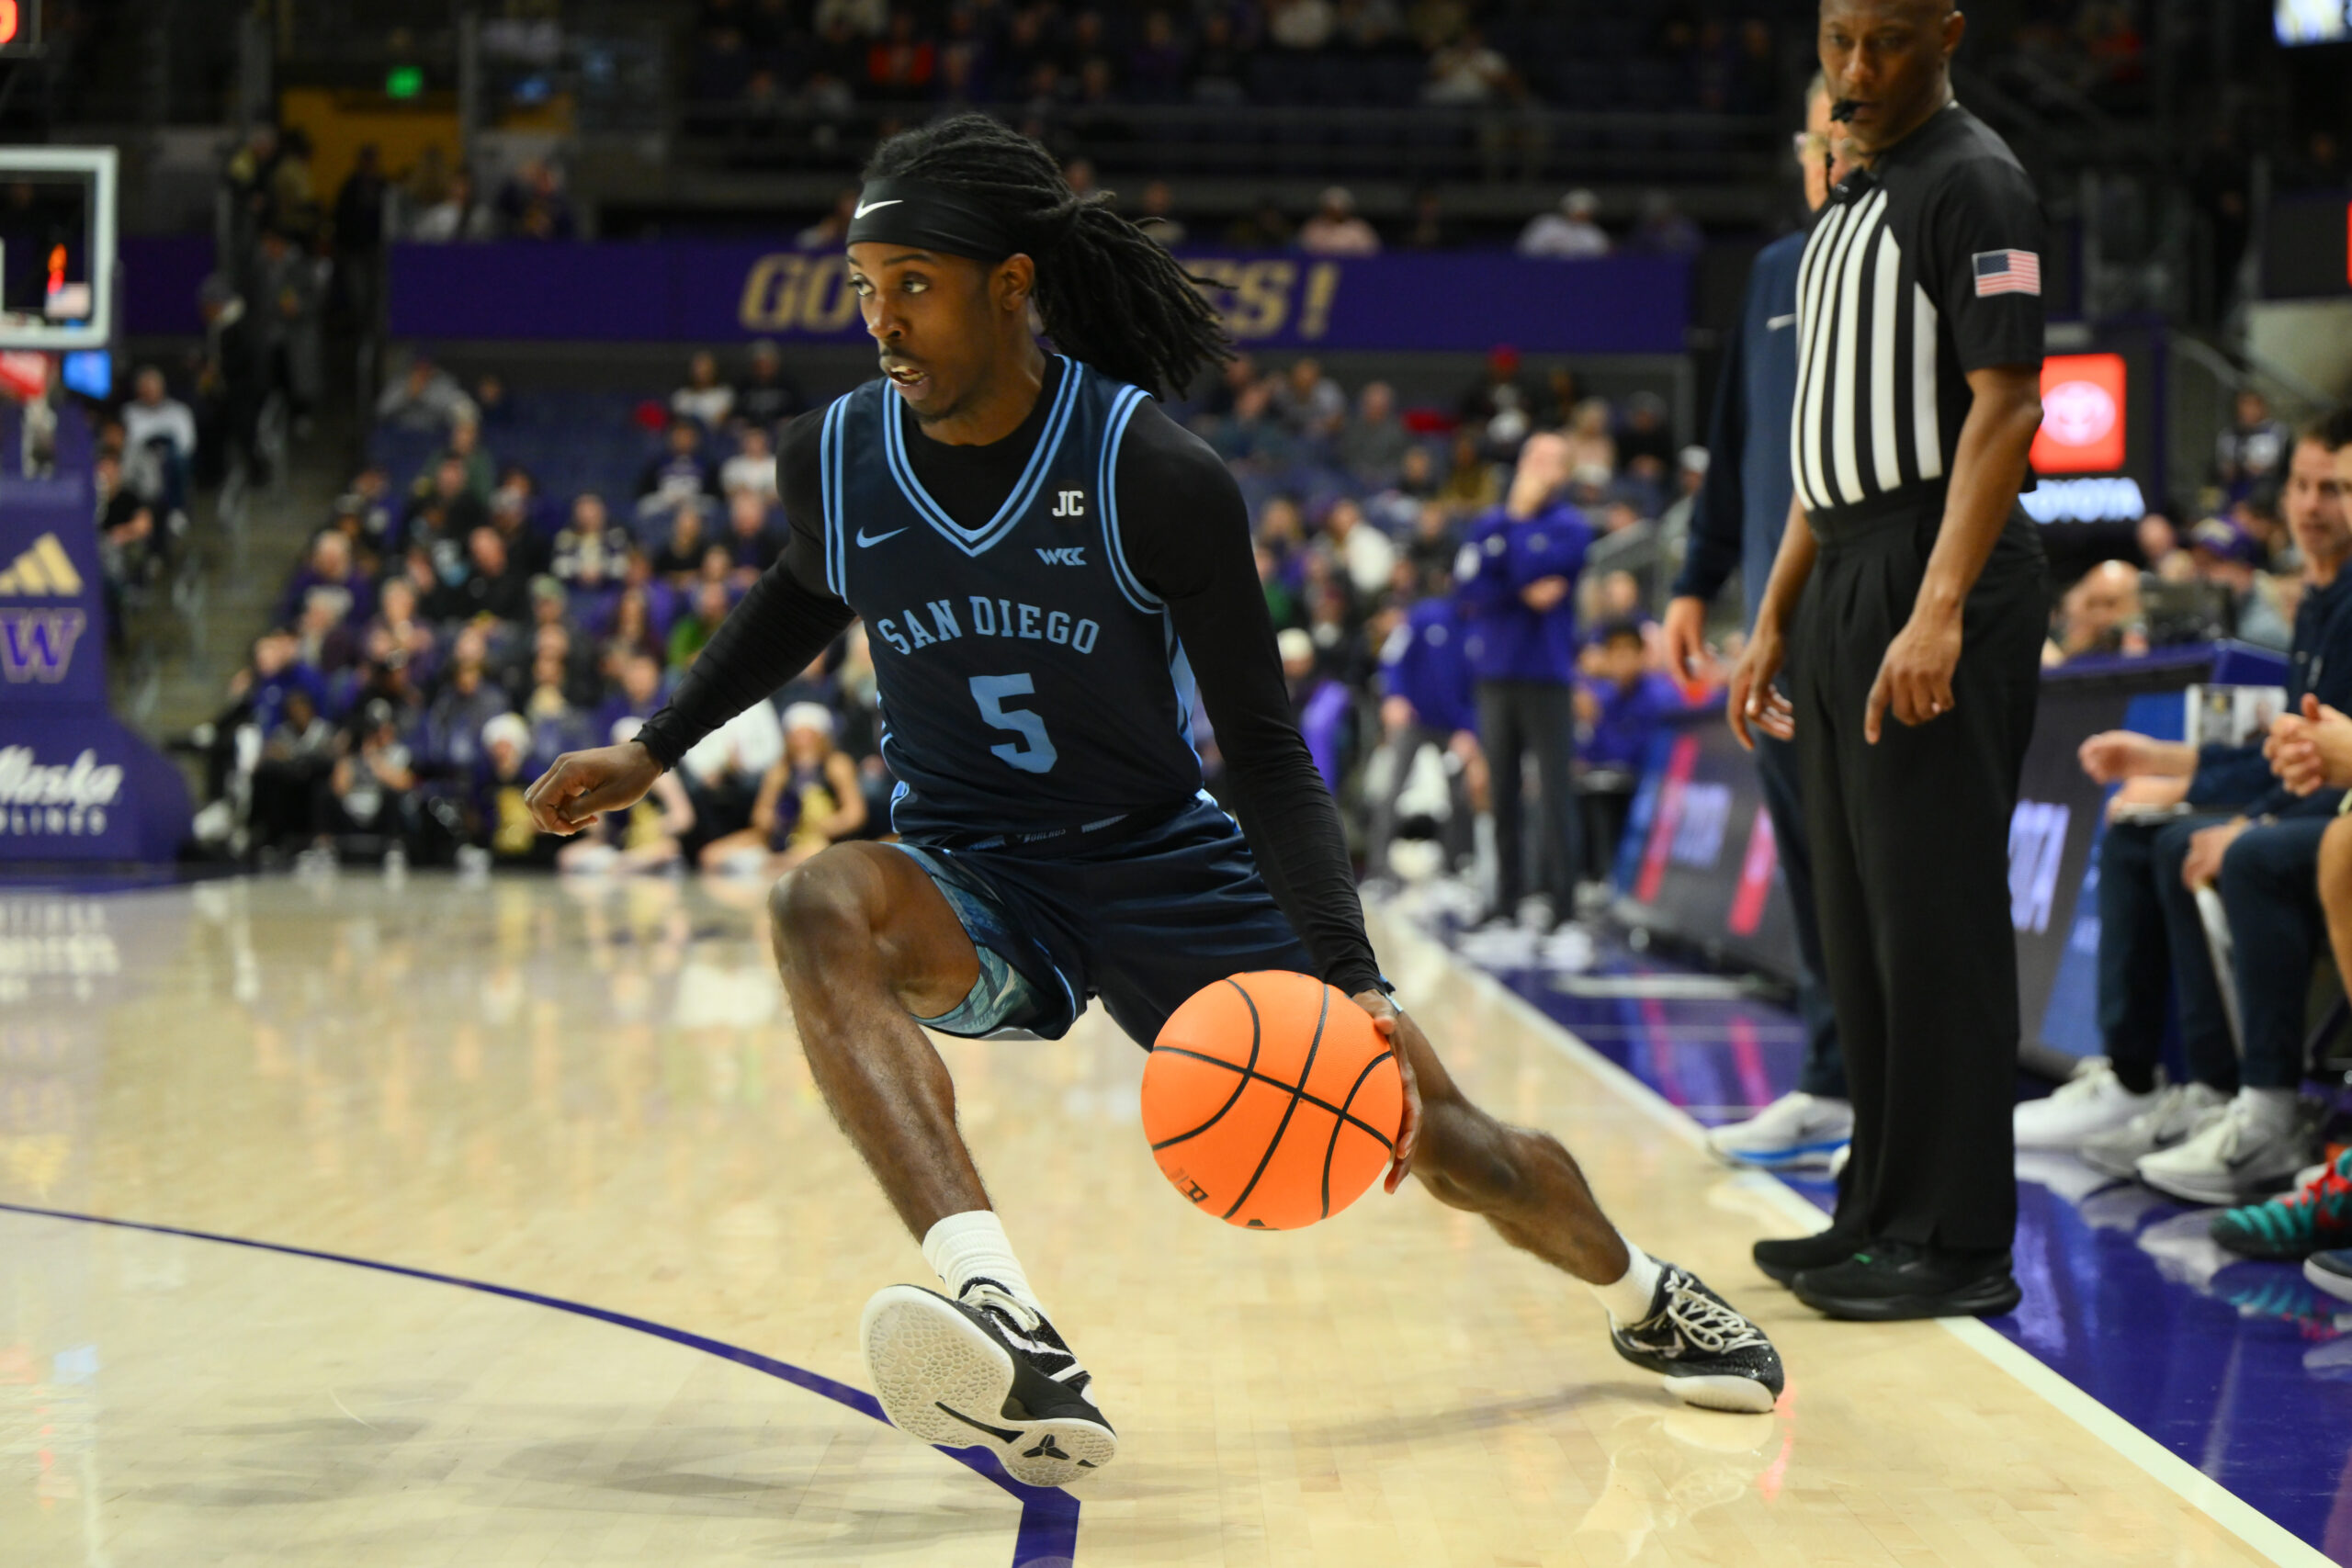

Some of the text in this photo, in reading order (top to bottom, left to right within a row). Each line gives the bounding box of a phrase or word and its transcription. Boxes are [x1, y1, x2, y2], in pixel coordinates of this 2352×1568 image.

[741, 254, 858, 332] GO
[1052, 491, 1084, 516] JC
[2018, 477, 2145, 525] OYOTA
[1035, 547, 1087, 566] WCC
[877, 596, 1100, 655] SAN DIEGO
[968, 673, 1057, 773] 5
[0, 807, 107, 836] LINES
